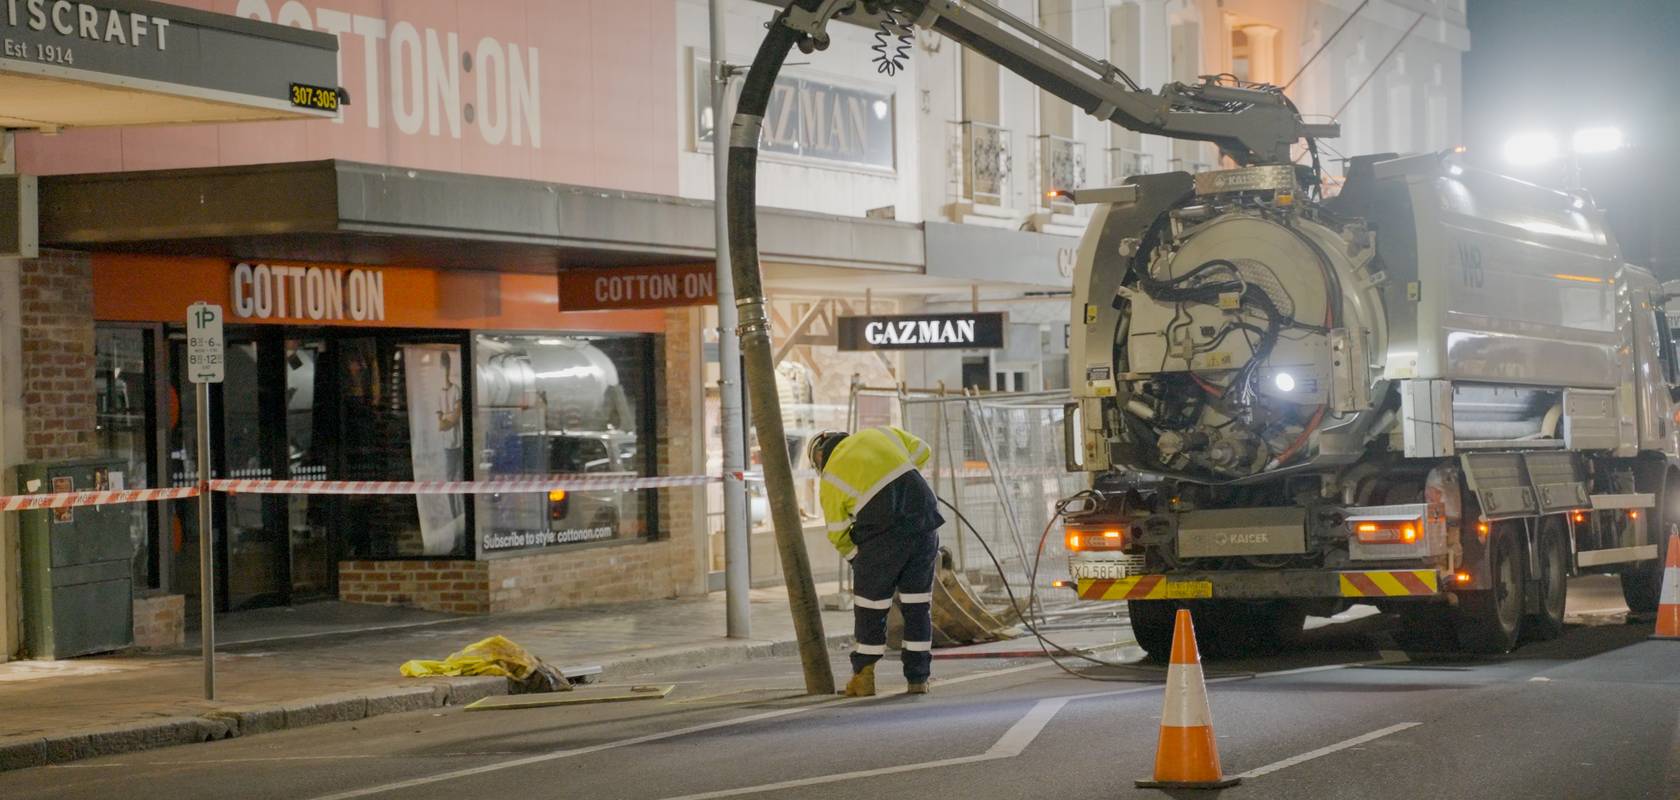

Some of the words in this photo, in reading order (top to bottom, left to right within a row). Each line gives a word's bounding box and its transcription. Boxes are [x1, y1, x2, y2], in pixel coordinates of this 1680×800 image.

[4, 39, 27, 58] Est
[37, 44, 73, 64] 1914
[293, 86, 336, 108] 307-305
[233, 263, 343, 320] COTTON
[348, 269, 384, 320] ON
[595, 274, 677, 302] COTTON
[684, 272, 712, 298] ON
[865, 320, 975, 344] GAZMAN
[483, 530, 525, 550] Subscribe
[525, 531, 535, 545] to
[557, 526, 612, 543] cottonon.com
